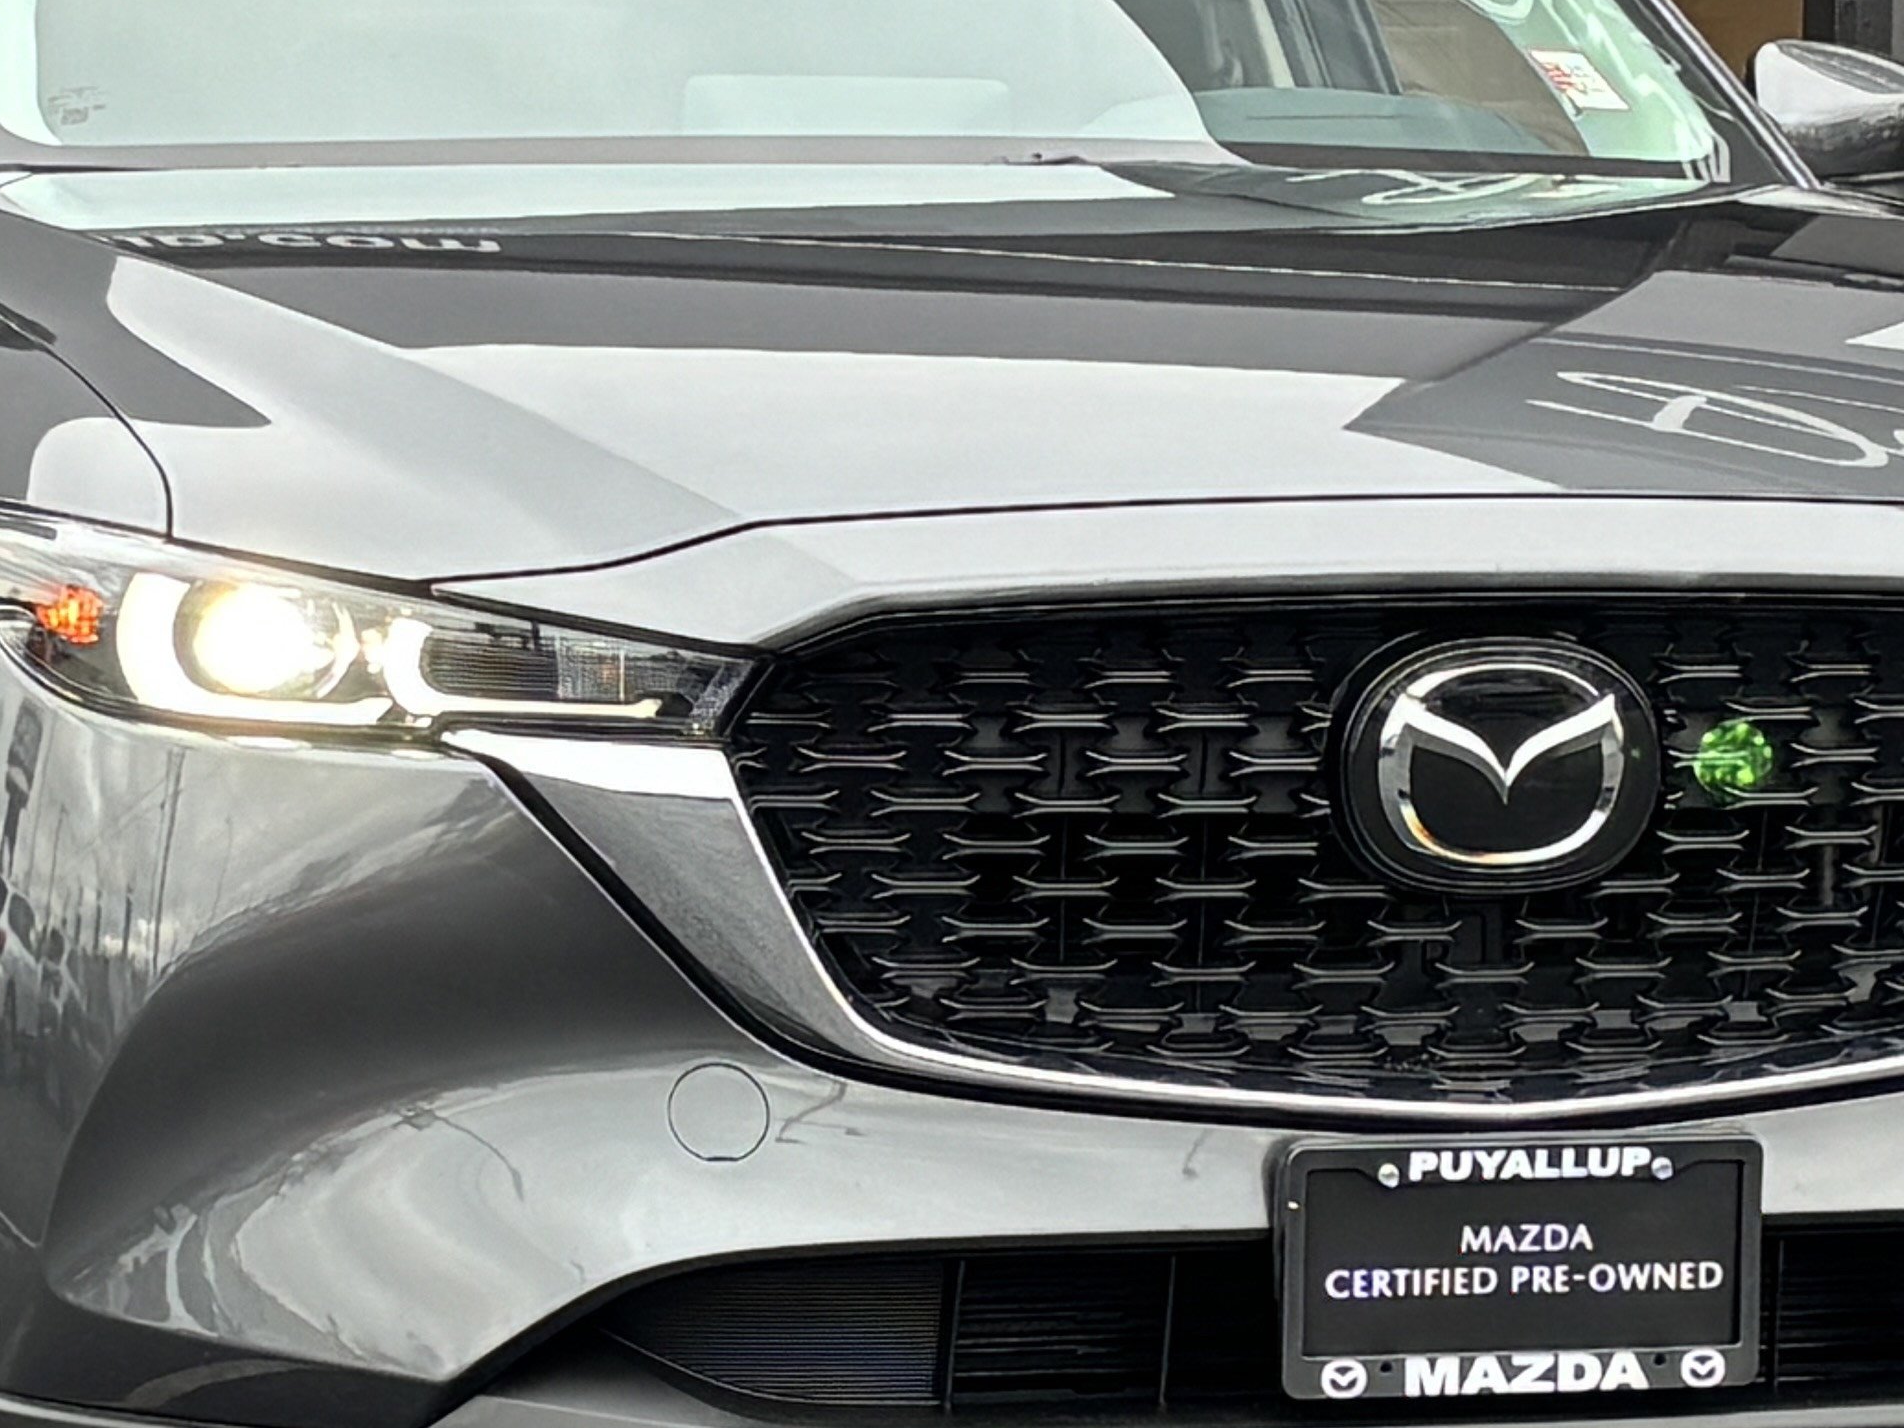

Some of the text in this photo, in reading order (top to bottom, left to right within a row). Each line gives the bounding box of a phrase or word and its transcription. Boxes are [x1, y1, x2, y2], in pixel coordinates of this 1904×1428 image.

[1408, 1146, 1652, 1184] PUYALLUP
[1459, 1222, 1594, 1255] MAZDA
[1324, 1260, 1725, 1301] CERTIFIED PRE-OWNED
[1402, 1347, 1651, 1399] MAZDA
